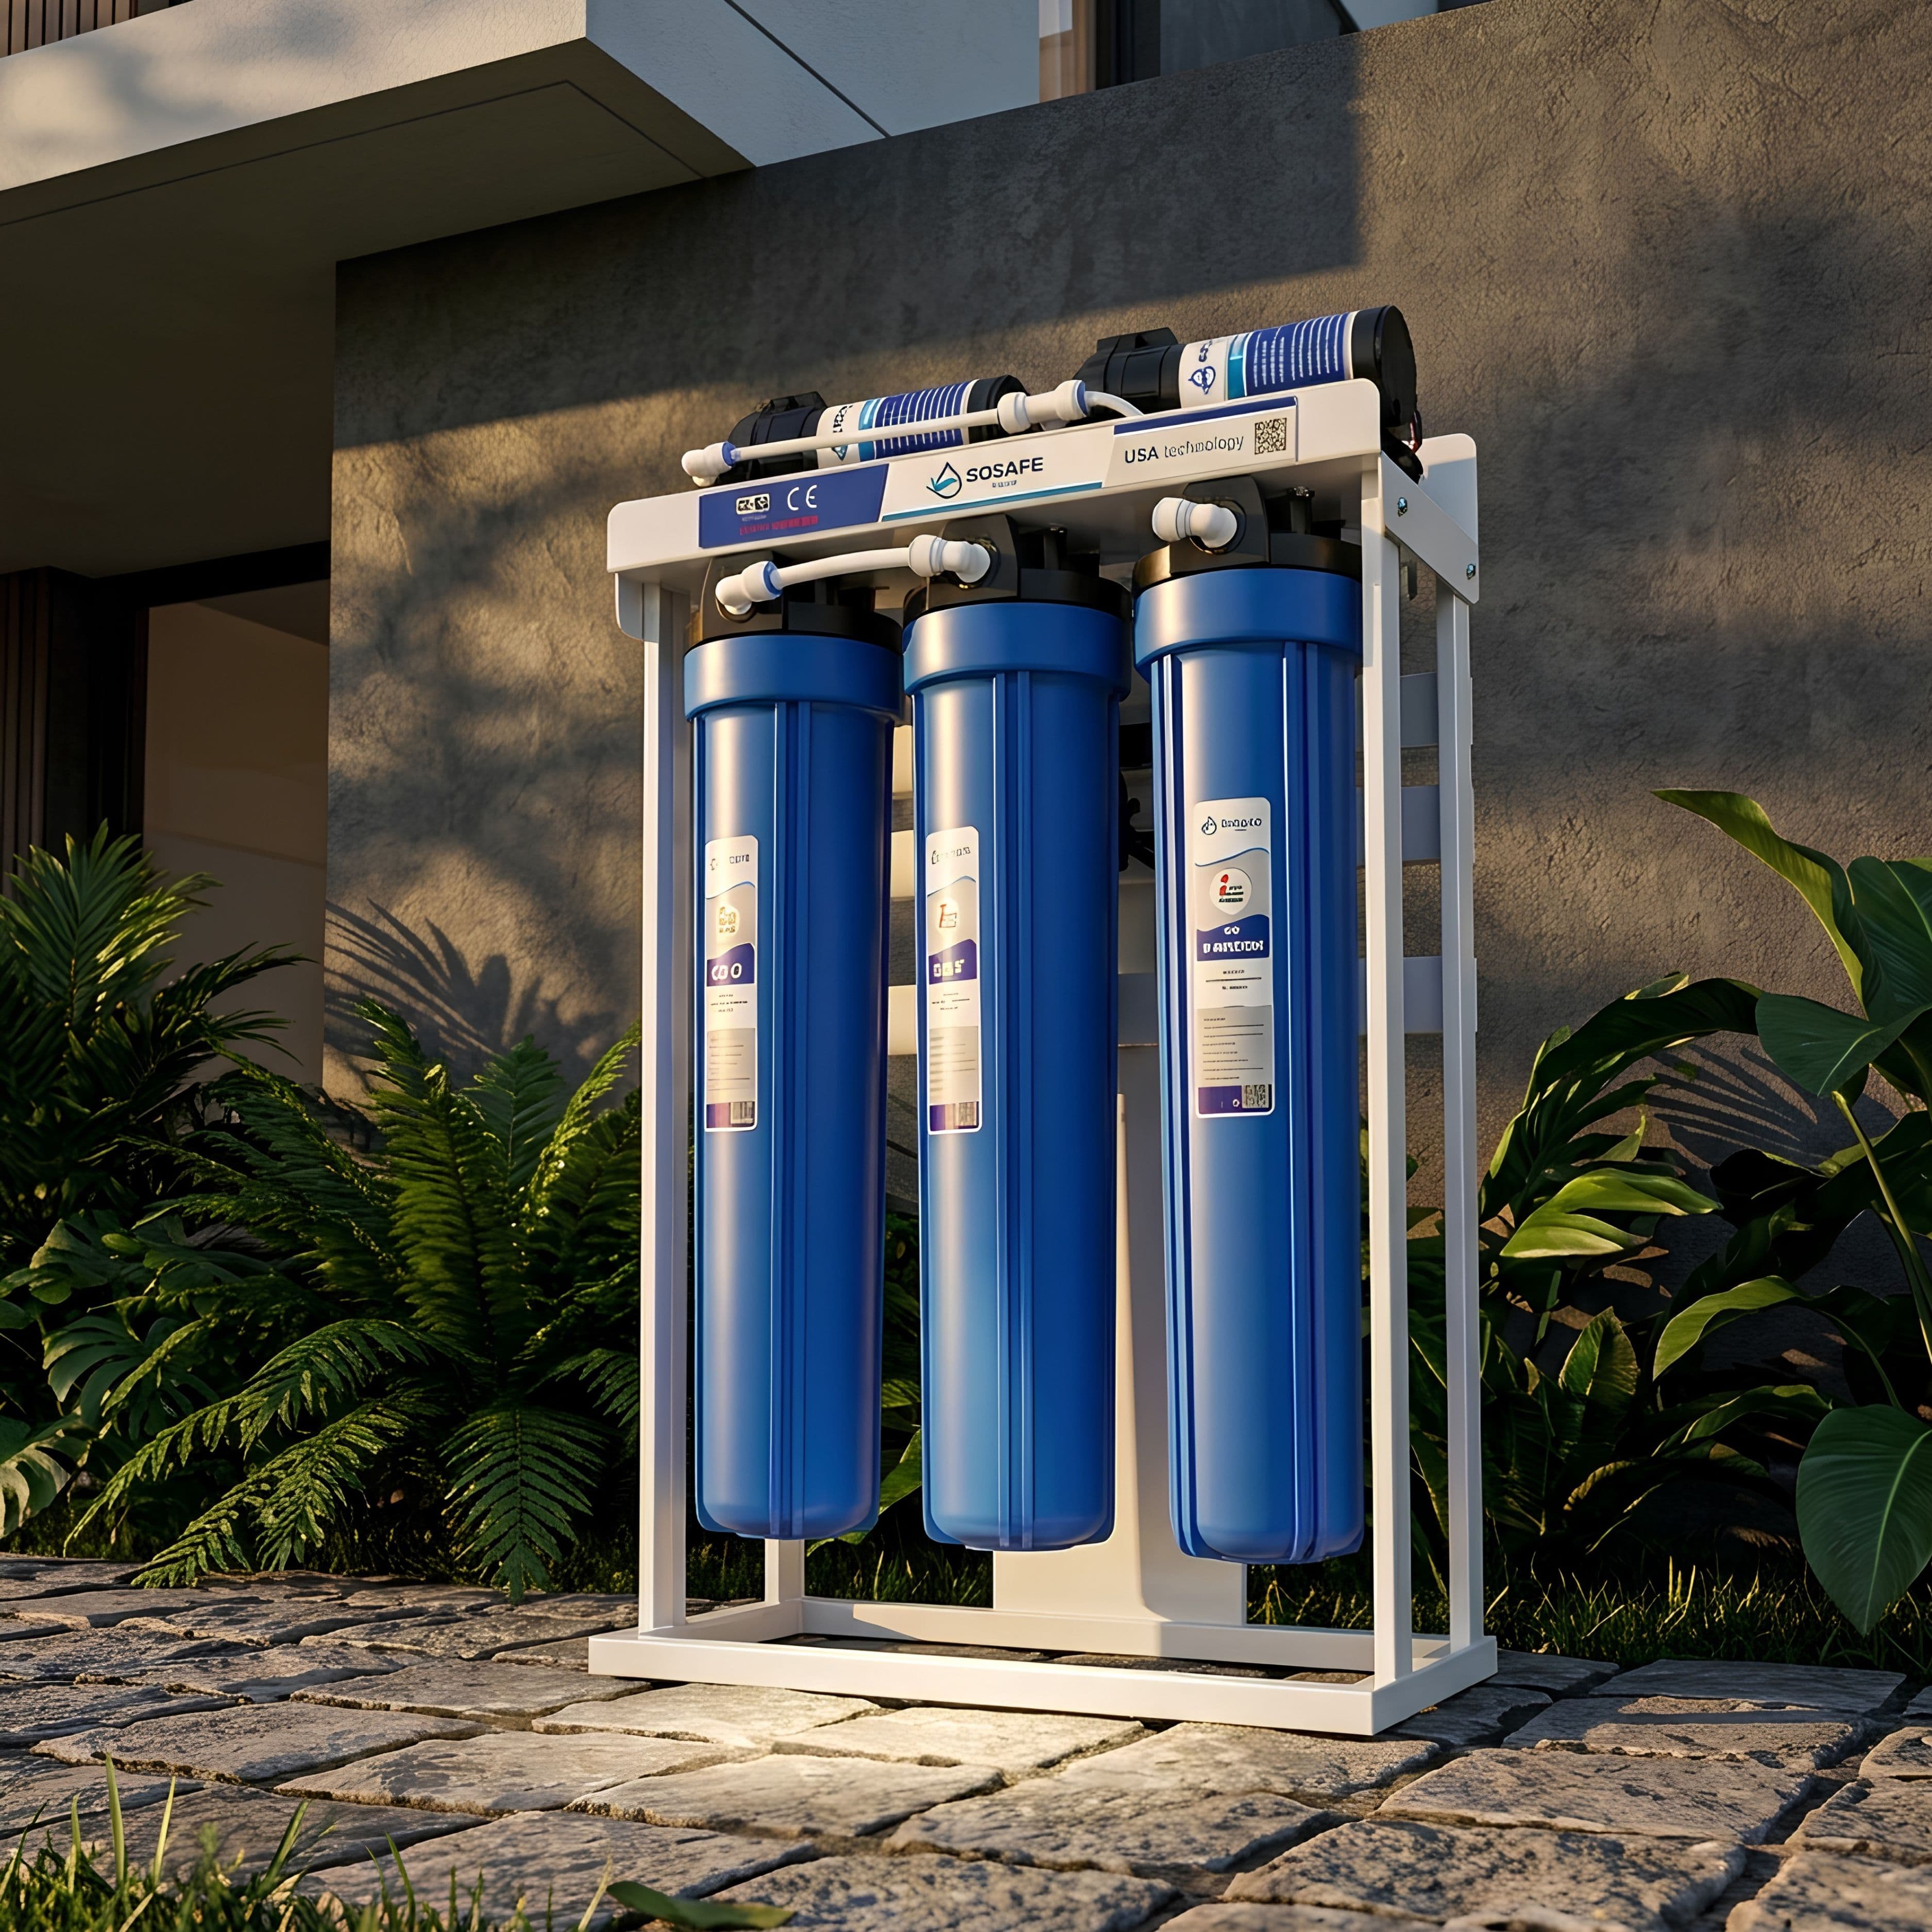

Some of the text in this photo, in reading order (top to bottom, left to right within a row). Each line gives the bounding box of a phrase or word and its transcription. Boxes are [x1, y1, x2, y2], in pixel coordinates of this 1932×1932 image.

[1125, 446, 1159, 464] USA
[966, 456, 1043, 482] SOSAFE
[787, 485, 818, 511] CE
